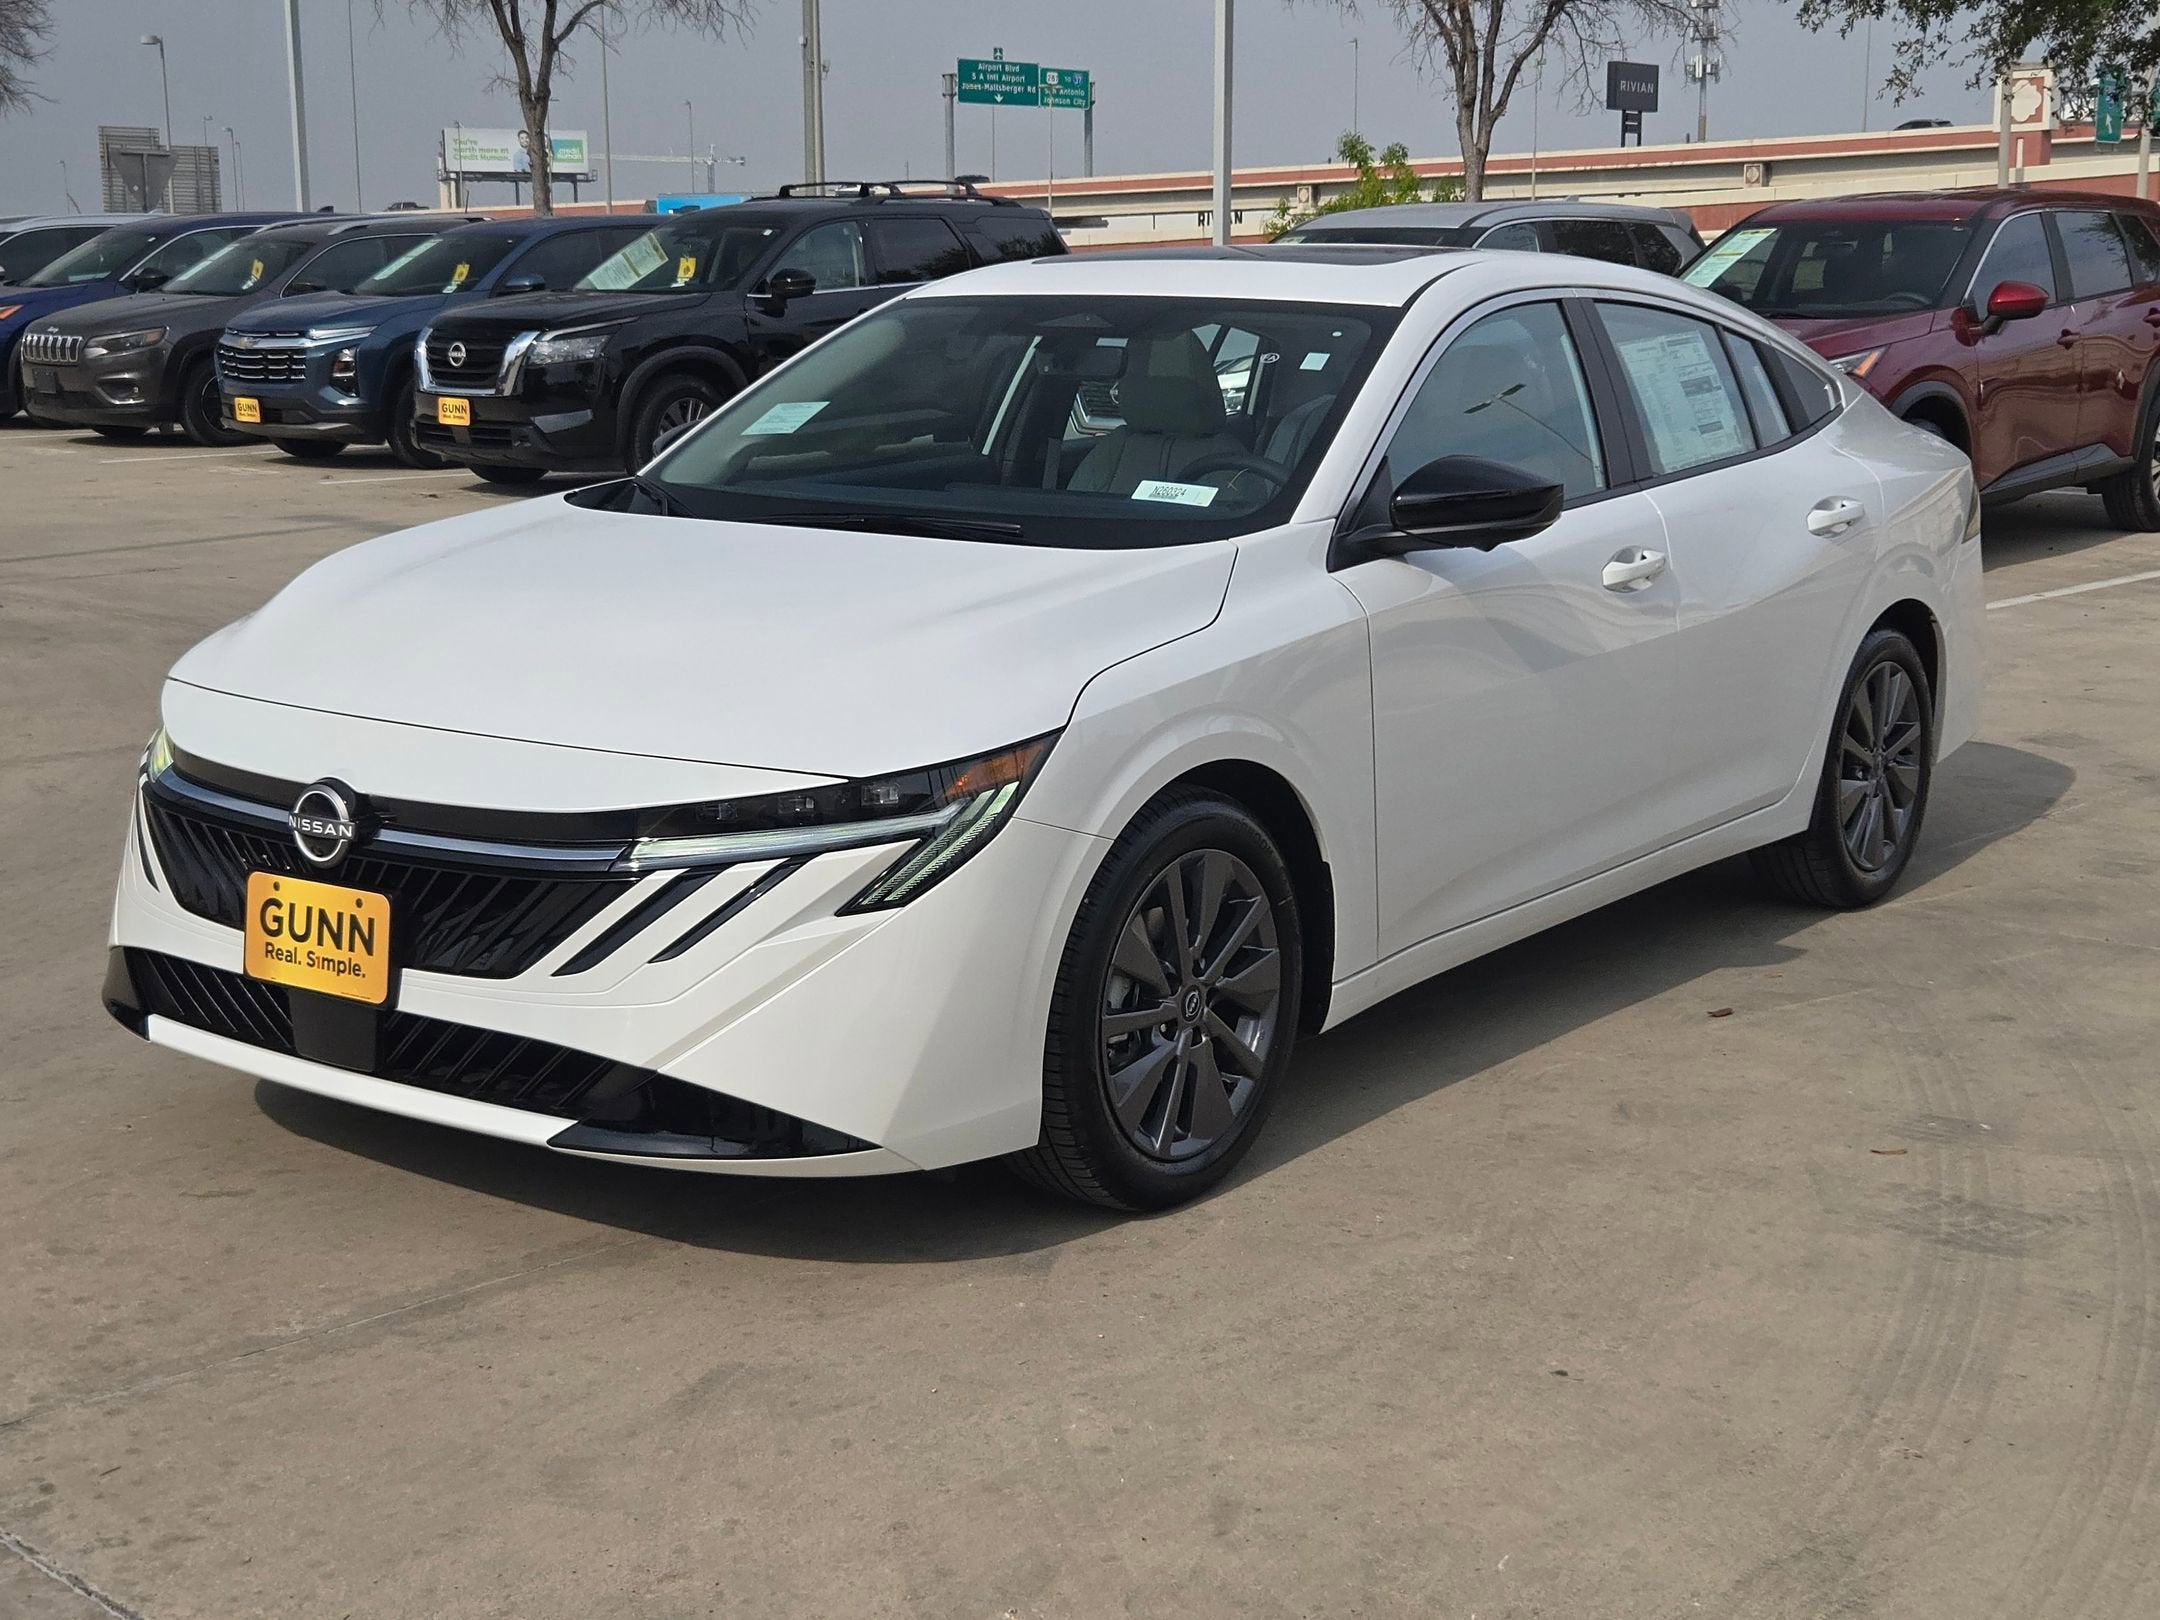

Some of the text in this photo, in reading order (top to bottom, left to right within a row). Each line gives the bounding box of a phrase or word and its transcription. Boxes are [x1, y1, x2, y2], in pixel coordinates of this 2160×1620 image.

[978, 63, 1020, 72] Airport Blvd
[1001, 75, 1025, 83] Airport
[1027, 86, 1036, 94] Rd
[1620, 79, 1654, 94] RIVIAN
[1060, 89, 1085, 97] Antonio
[1073, 98, 1086, 107] City
[1198, 211, 1243, 227] RIN
[441, 403, 468, 415] GUNN
[288, 815, 353, 838] NISSAN
[259, 897, 376, 957] GUNN
[264, 941, 302, 966] Real.
